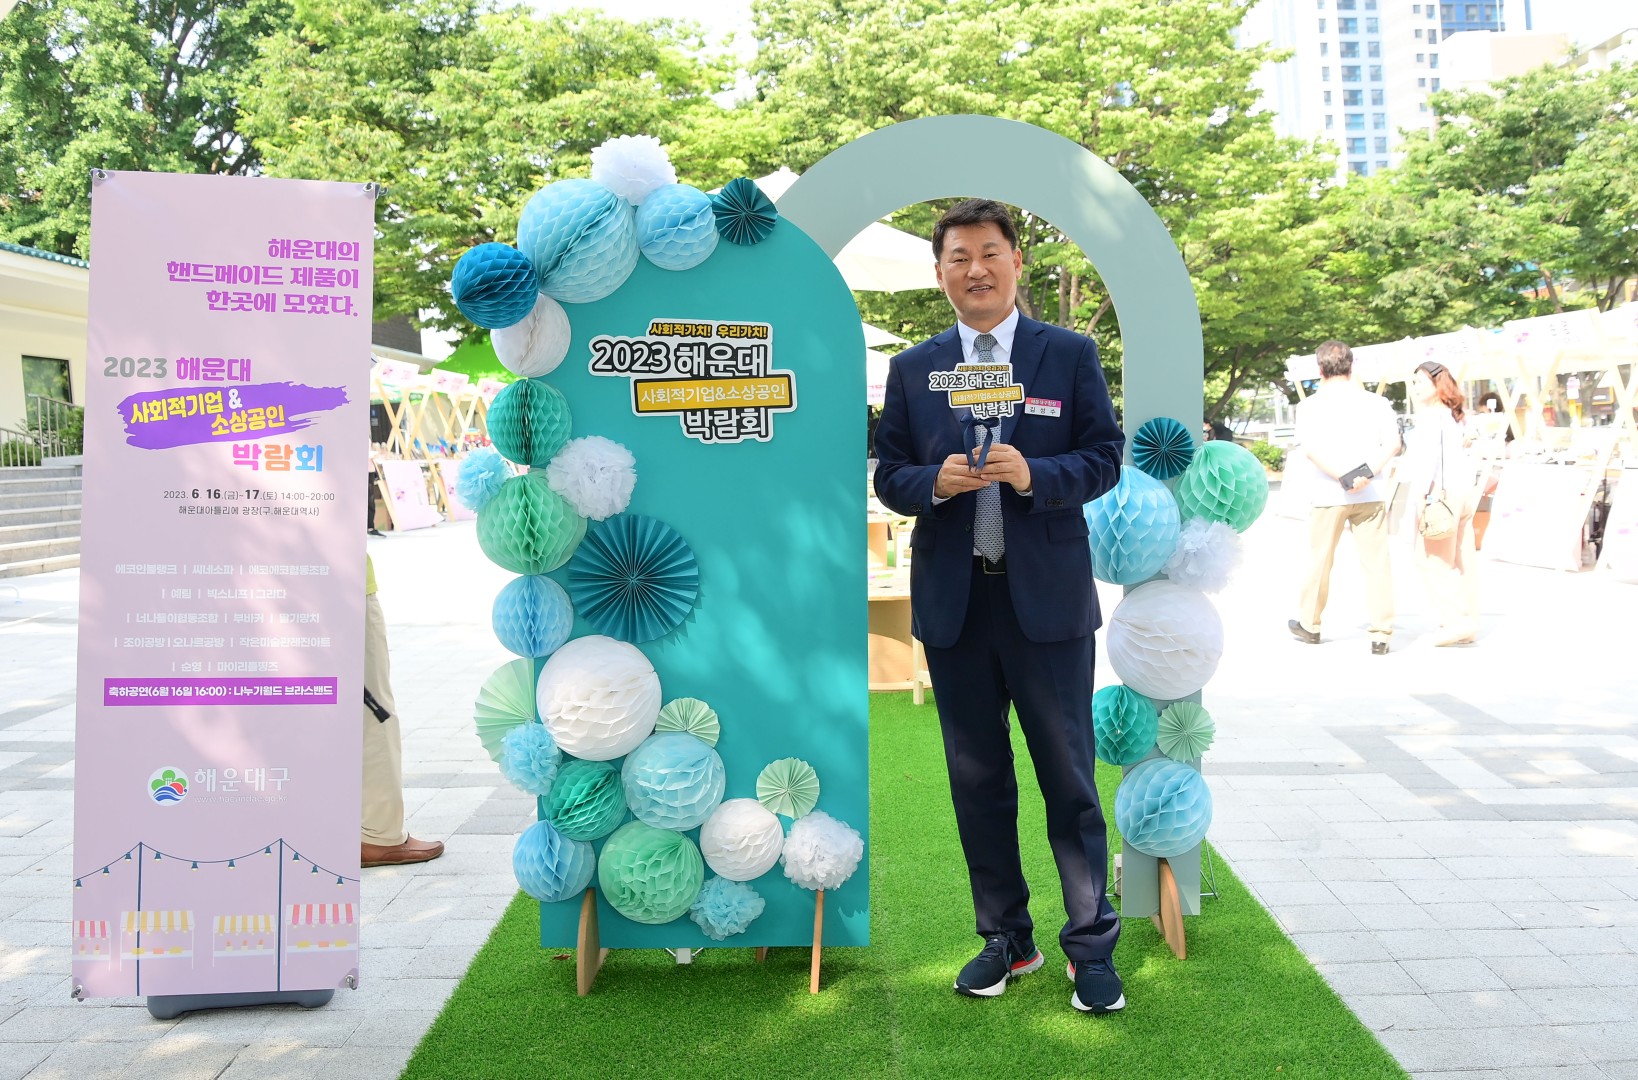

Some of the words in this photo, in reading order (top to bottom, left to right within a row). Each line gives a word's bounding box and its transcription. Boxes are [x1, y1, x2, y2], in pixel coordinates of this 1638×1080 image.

[268, 238, 360, 262] 해운대의
[166, 260, 284, 286] 핸드메이드
[290, 266, 359, 289] 제품이
[206, 289, 277, 313] 한곳에
[282, 293, 359, 317] 모였다.
[650, 322, 712, 338] 사회적가치!
[716, 324, 769, 339] 우리가치!
[103, 356, 168, 379] 2023
[175, 357, 252, 382] 해운대
[592, 340, 670, 374] 2023
[675, 343, 767, 377] 해운대
[930, 373, 966, 389] 2023
[968, 372, 1011, 389] 해운대
[130, 390, 224, 425] 사회적기업
[228, 388, 243, 410] &
[641, 383, 786, 405] 사회적기업&소상공인
[211, 404, 286, 436] 소상공인
[974, 401, 1012, 417] 박람회
[686, 407, 767, 438] 박람회
[232, 443, 323, 472] 박람회
[163, 490, 189, 499] 2023.
[178, 505, 239, 516] 해운대아틀리에
[255, 588, 287, 600] 그리다
[109, 686, 169, 697] 축하공연(6월
[171, 685, 193, 697] 16일
[195, 685, 227, 698] 16:00)
[285, 685, 333, 697] 브라스밴드
[194, 767, 291, 793] 해운대구
